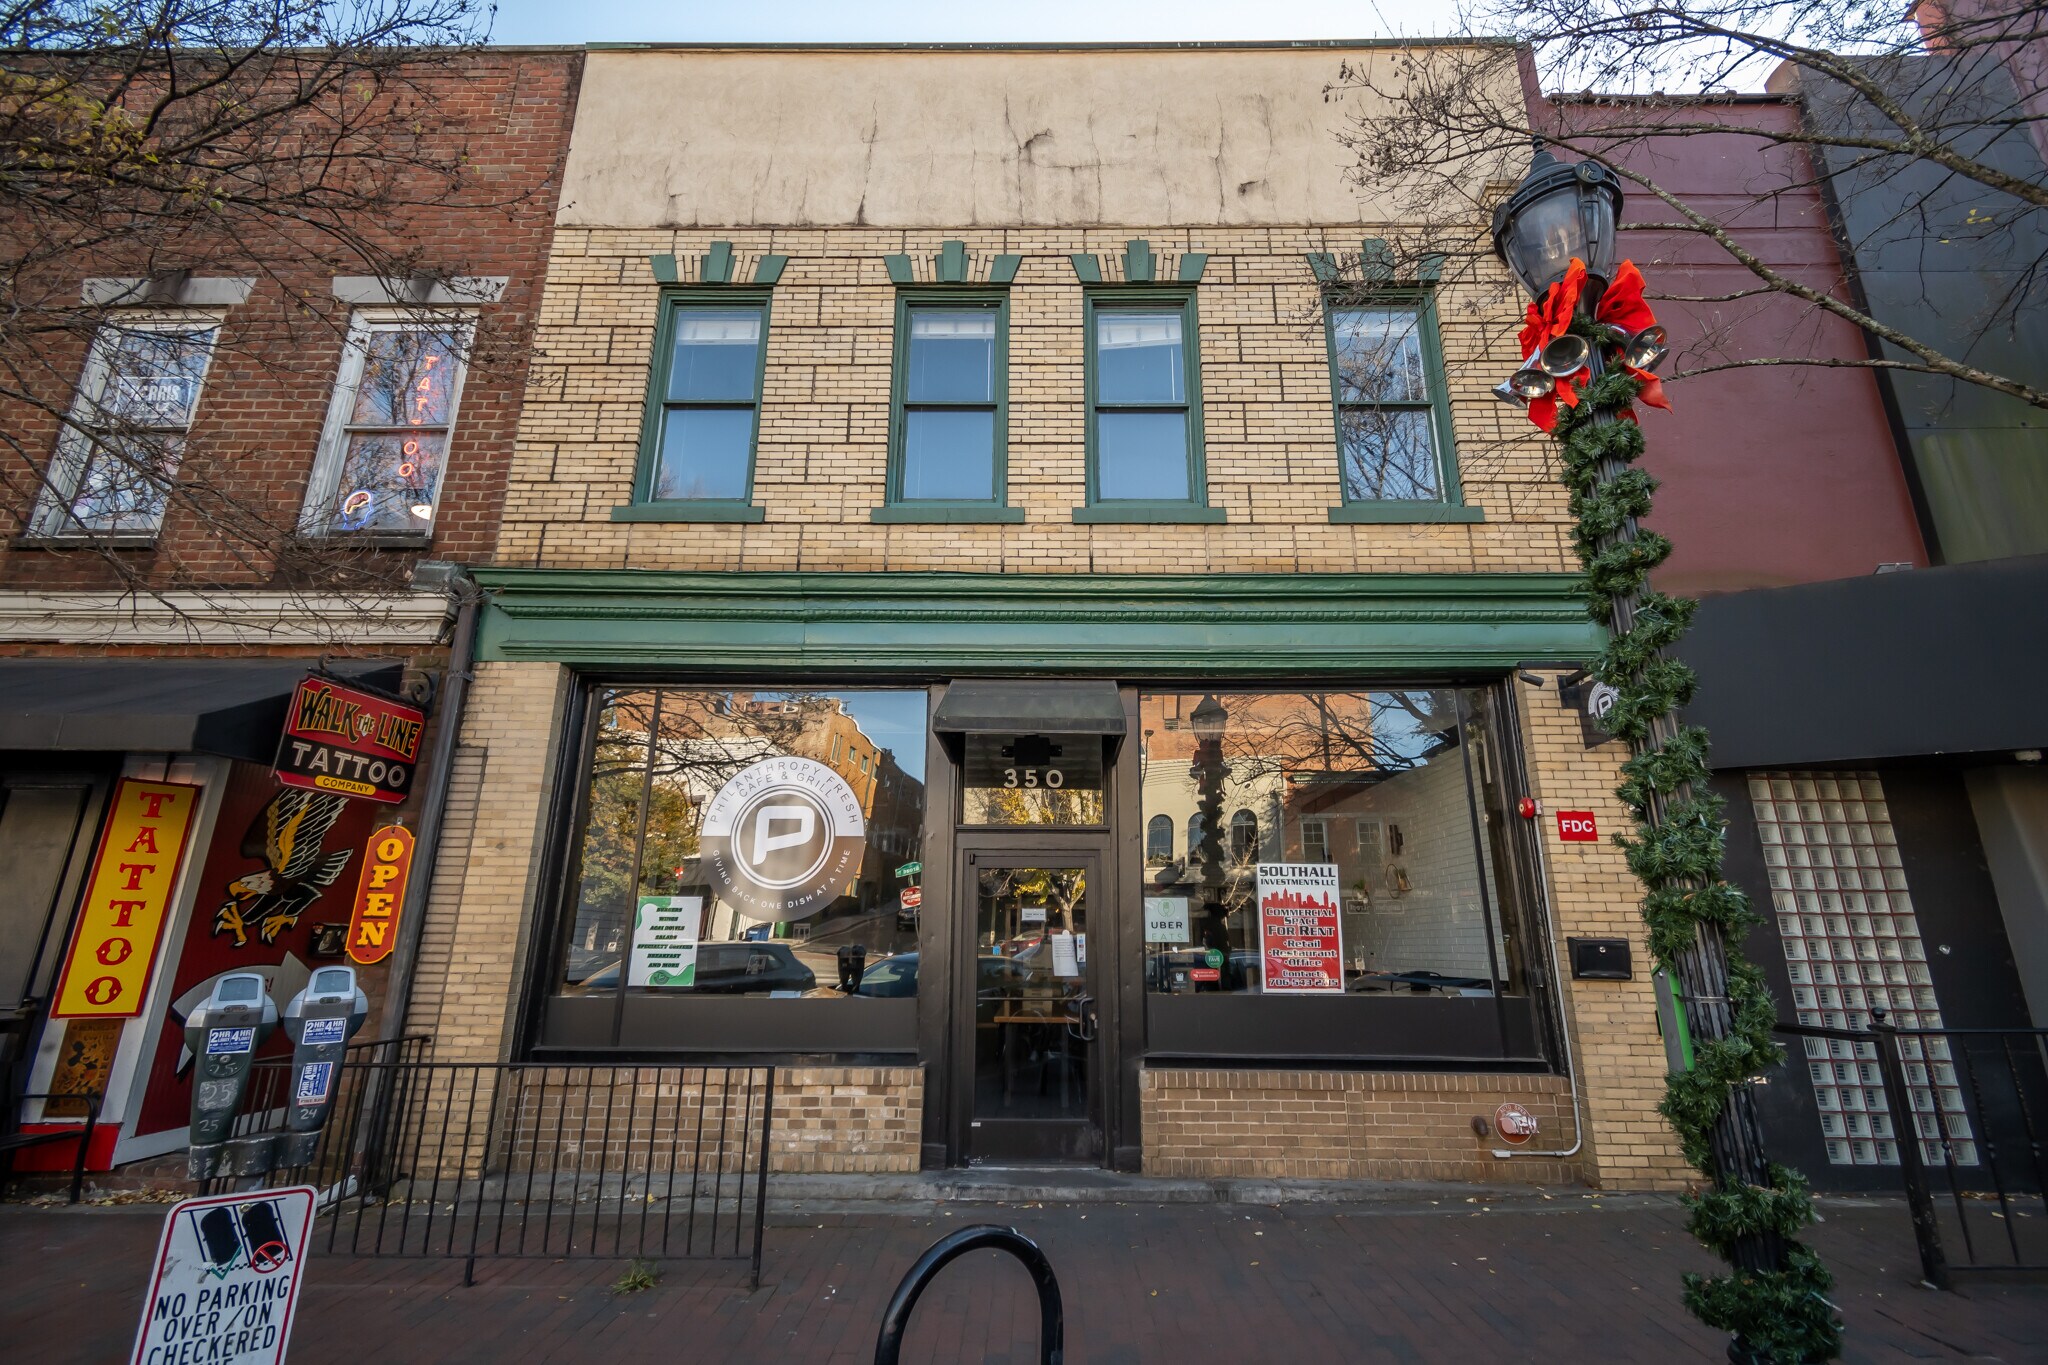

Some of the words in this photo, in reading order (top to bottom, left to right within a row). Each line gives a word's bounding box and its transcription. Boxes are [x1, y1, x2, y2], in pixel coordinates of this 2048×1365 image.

[296, 686, 361, 743] WALK
[356, 713, 377, 735] THE
[374, 711, 422, 758] LINE
[292, 741, 405, 788] TATTOO
[322, 777, 370, 793] COMPANY
[739, 773, 773, 798] CAFE
[781, 771, 788, 780] &
[796, 773, 832, 798] GRILL
[1003, 768, 1064, 788] 350
[710, 761, 821, 824] PHILANTHROPY
[826, 776, 858, 824] FRESH
[1561, 819, 1593, 833] FDC
[753, 806, 815, 866] P
[713, 849, 732, 885] GIVING
[731, 886, 756, 905] BACK
[761, 900, 782, 910] ONE
[787, 894, 813, 909] DISH
[816, 884, 828, 896] AT
[829, 877, 836, 885] A
[836, 849, 851, 874] TIME
[1259, 866, 1336, 878] SOUTHALL
[1261, 878, 1320, 886] INVESTMENTS
[84, 791, 175, 1006] TATTOO
[357, 838, 405, 948] OPEN
[1266, 907, 1335, 917] COMMERCIAL
[1284, 917, 1318, 925] SPACE
[1151, 921, 1183, 929] UBER
[1267, 925, 1296, 936] FOR
[1299, 925, 1335, 937] RENT
[1151, 933, 1183, 941] EATS
[300, 1108, 317, 1120] 24
[199, 1119, 219, 1132] 25
[154, 1293, 186, 1321] NO
[196, 1275, 290, 1314] PARKING
[147, 1325, 276, 1365] CHECKERED
